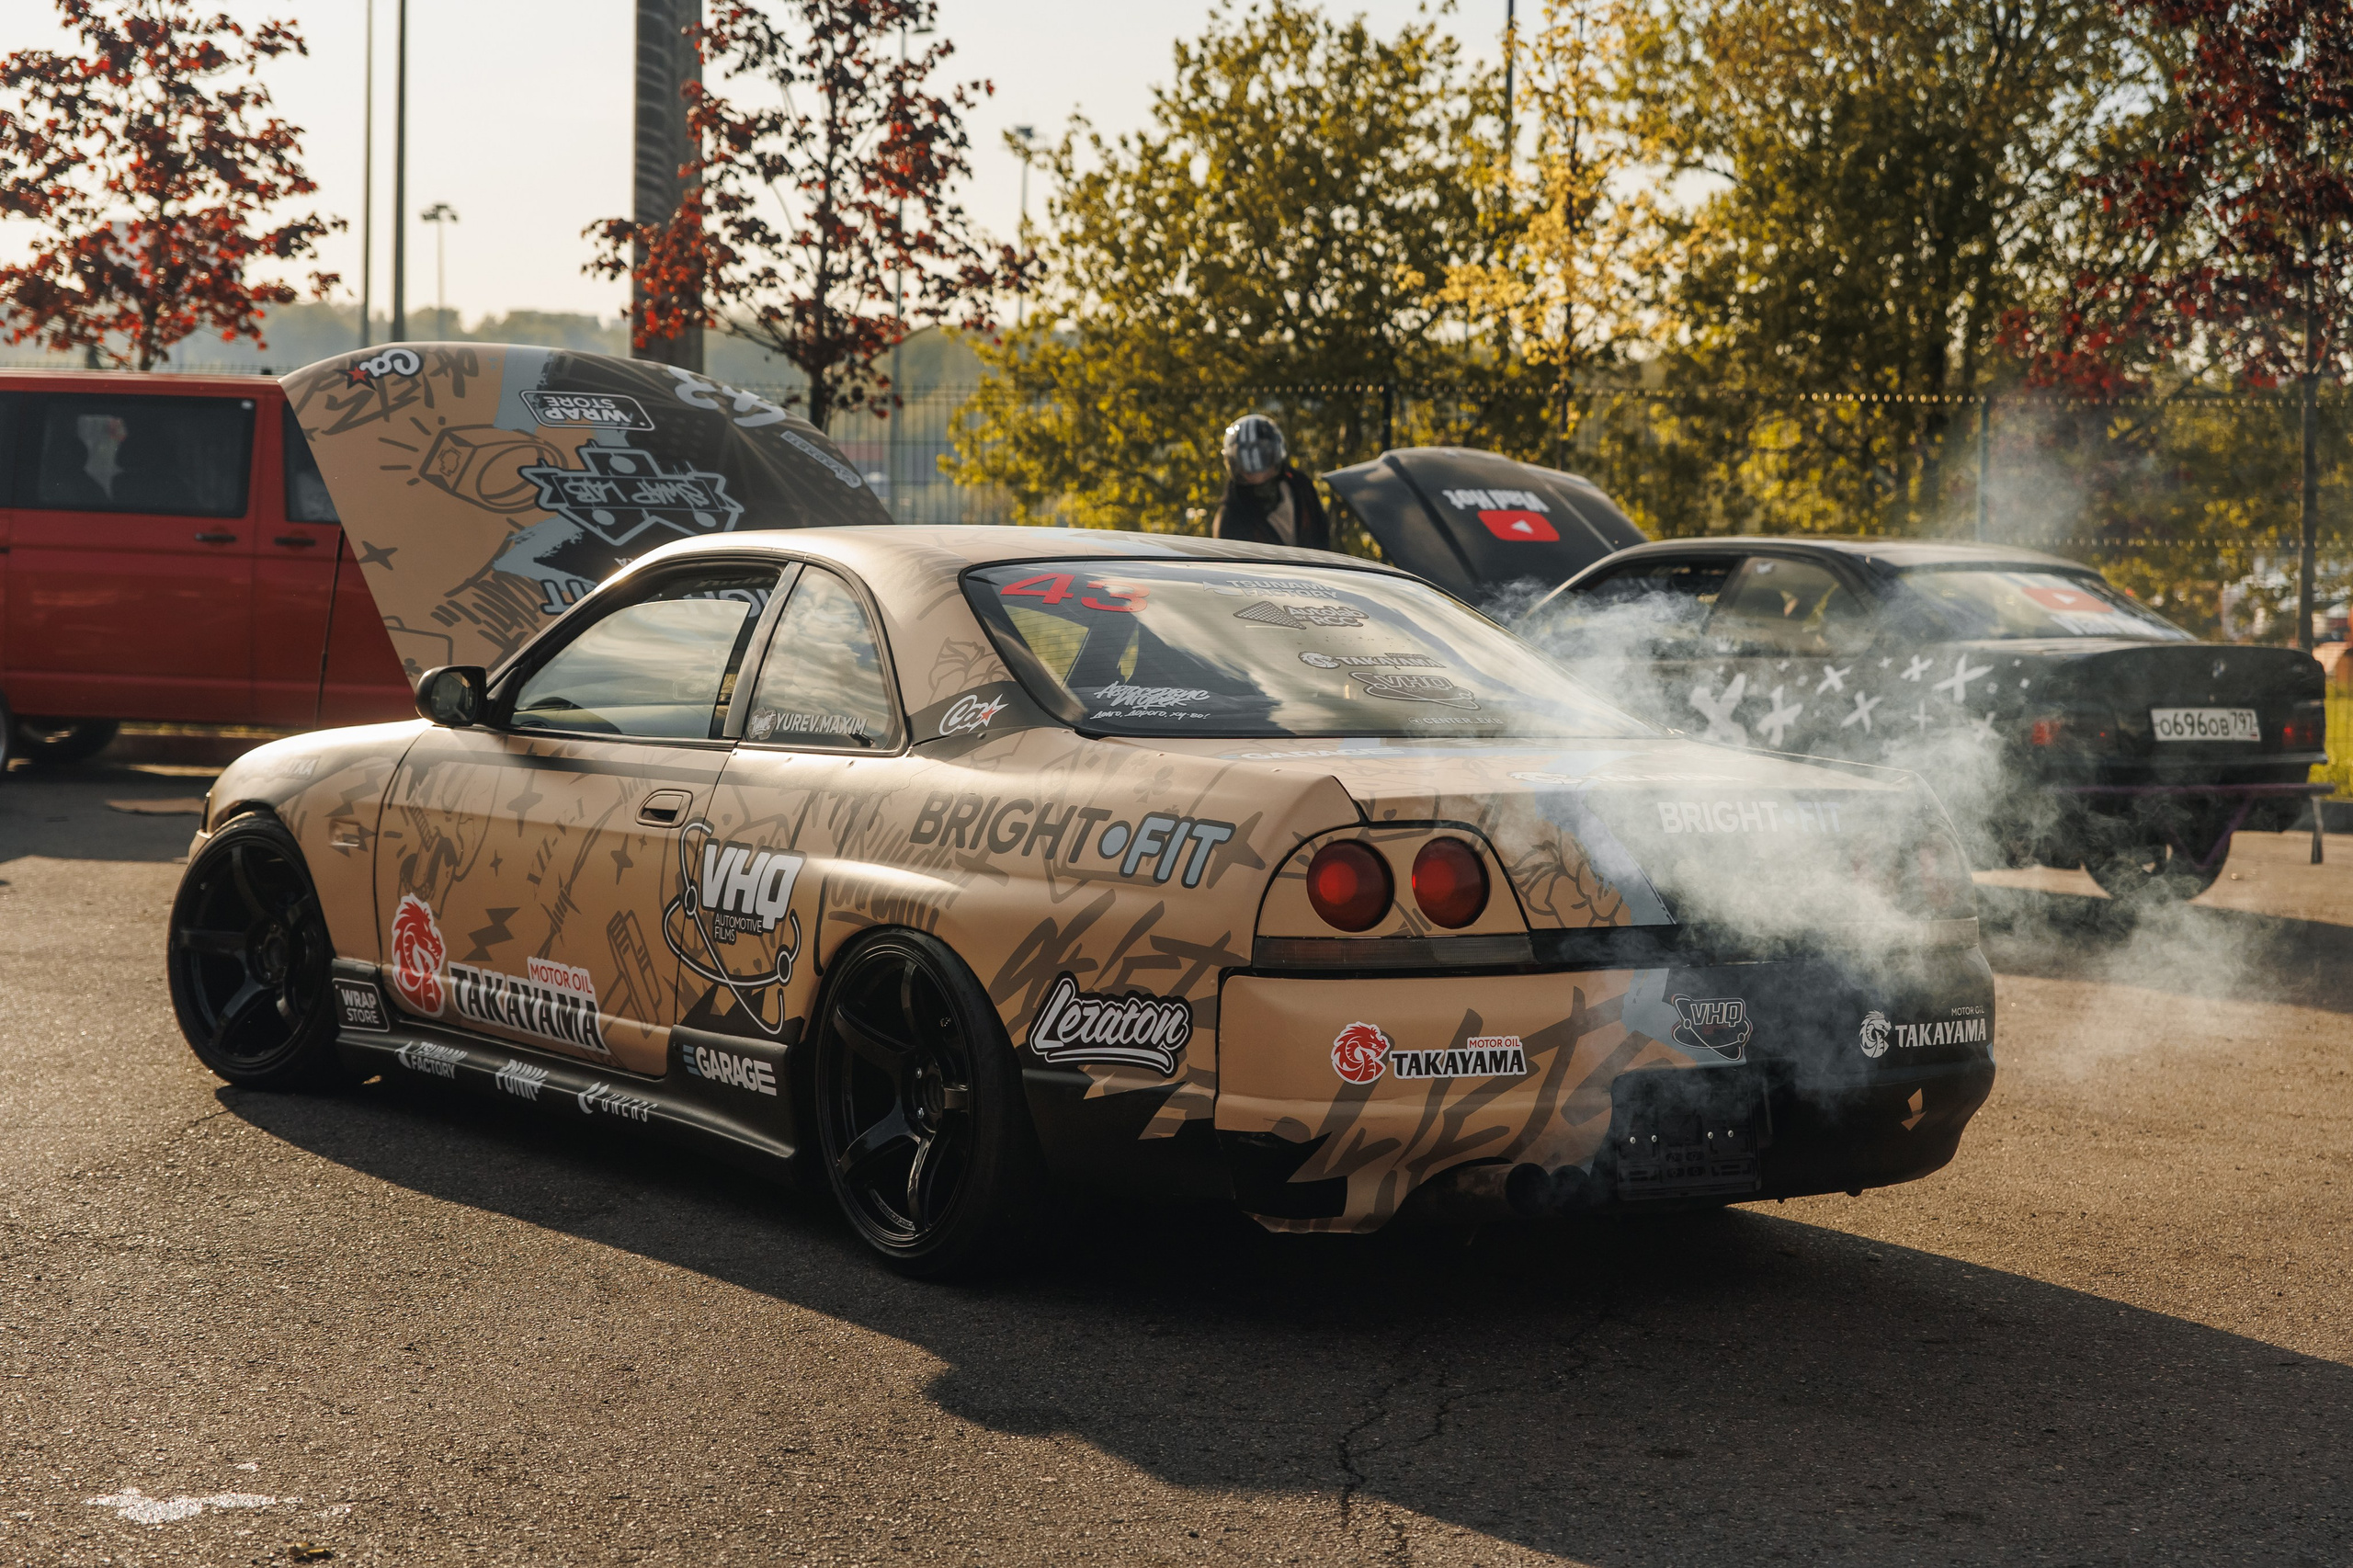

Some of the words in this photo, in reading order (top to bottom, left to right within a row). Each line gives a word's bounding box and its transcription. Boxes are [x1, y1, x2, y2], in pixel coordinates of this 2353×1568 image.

[543, 395, 617, 409] STORE
[544, 407, 632, 422] WRAP
[564, 481, 628, 505] LAB
[632, 481, 709, 506] SWAP
[1000, 573, 1150, 612] 43
[1226, 580, 1332, 591] TSUNAMI
[1242, 588, 1337, 599] FACTORY
[1288, 606, 1366, 619] Autolab
[1313, 616, 1362, 626] RCC
[1335, 656, 1444, 668] TAKAYAMA
[1378, 676, 1454, 690] VHQ
[776, 713, 869, 735] YUREV.MAXIM
[1425, 717, 1504, 725] CENTER_EKB
[1241, 747, 1404, 759] GARAGE
[1657, 801, 1779, 834] BRIGHT
[1794, 801, 1841, 833] FIT
[909, 790, 1113, 863] BRIGHT
[1120, 813, 1235, 887] FIT
[702, 844, 803, 929] VHQ
[714, 914, 763, 933] AUTOMOTIVE
[714, 926, 735, 941] FILMS
[529, 962, 570, 988] MOTOR
[573, 973, 593, 994] OIL
[340, 989, 378, 1009] WRAP
[347, 1008, 380, 1025] STORE
[449, 969, 607, 1051] TAKAYAMA
[1690, 1002, 1743, 1028] VHQ
[1951, 1006, 1974, 1017] MOTOR
[1975, 1006, 1985, 1014] OIL
[1895, 1017, 1987, 1048] TAKAYAMA
[414, 1041, 469, 1062] TSUNAMI
[1470, 1039, 1503, 1049] MOTOR
[1505, 1039, 1520, 1047] OIL
[411, 1055, 456, 1079] FACTORY
[696, 1046, 778, 1096] GARAGE
[1392, 1050, 1525, 1076] TAKAYAMA
